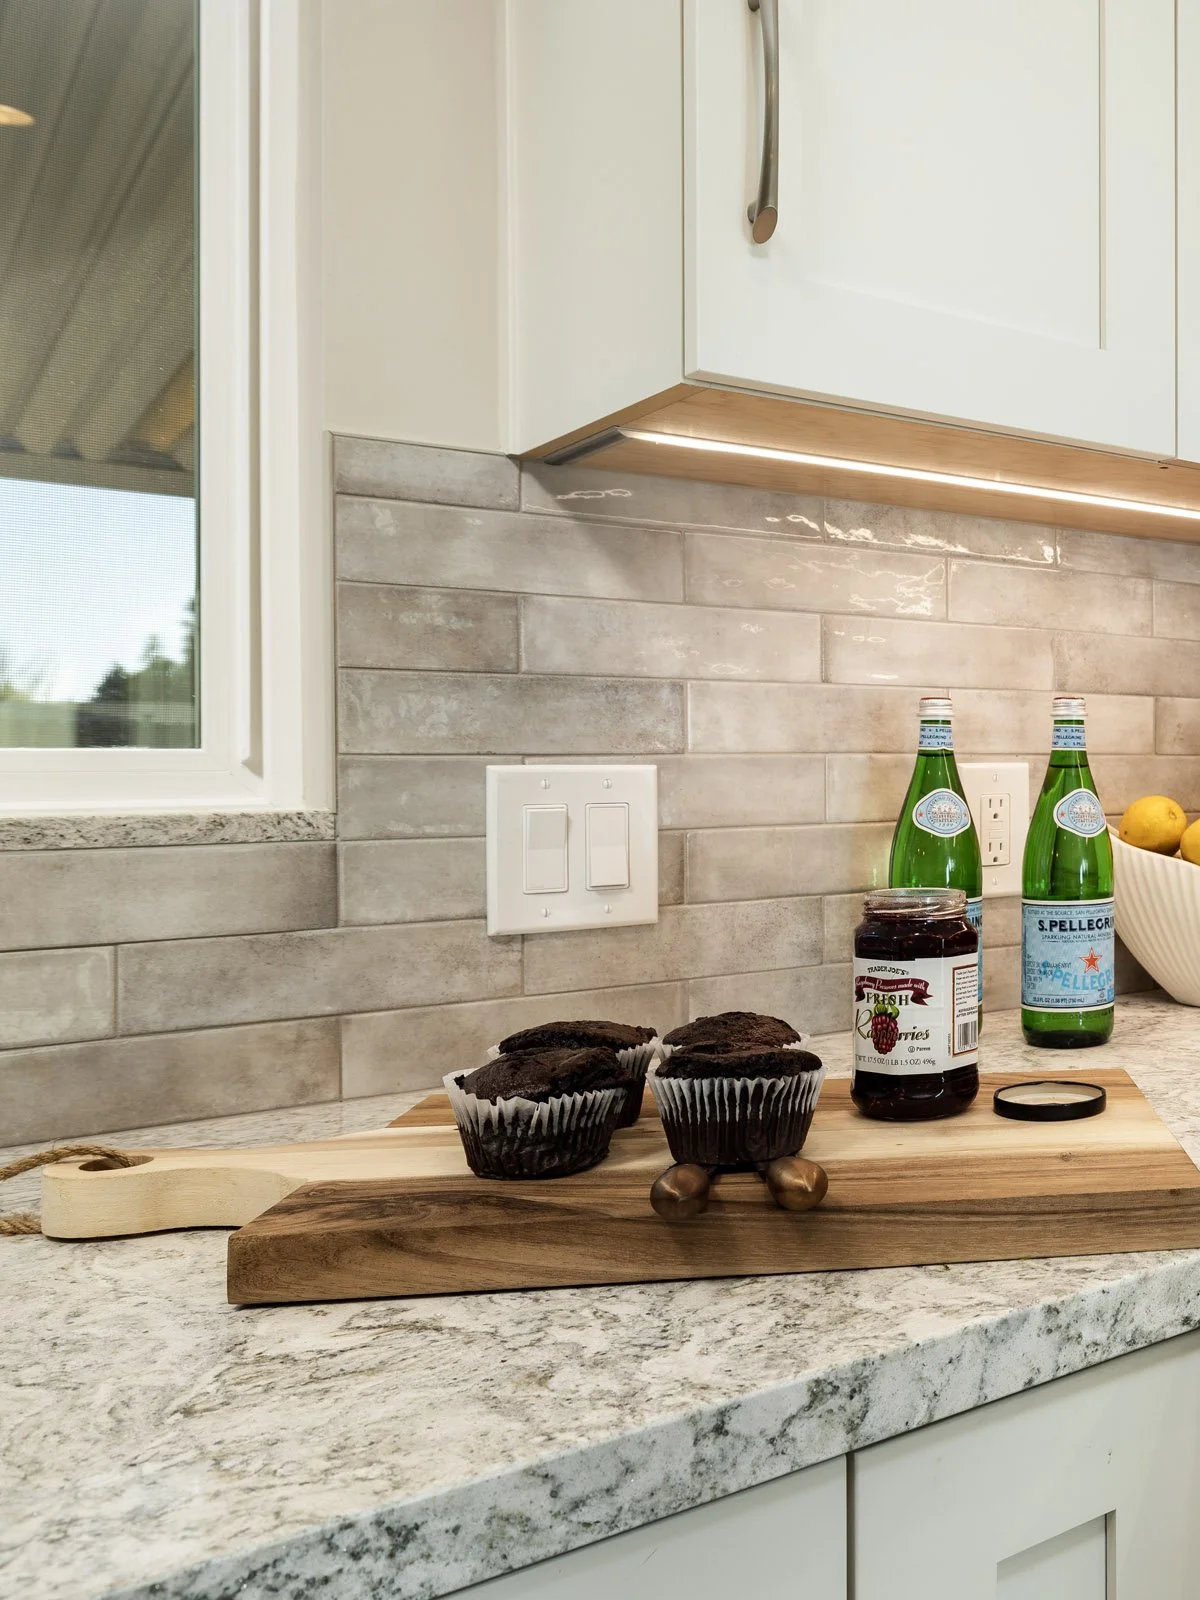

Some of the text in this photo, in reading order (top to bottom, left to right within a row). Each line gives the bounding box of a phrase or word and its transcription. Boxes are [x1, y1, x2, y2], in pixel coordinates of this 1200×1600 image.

[898, 979, 913, 988] made
[914, 981, 926, 990] with
[866, 992, 909, 1006] FRESH
[922, 1058, 936, 1066] 496g
